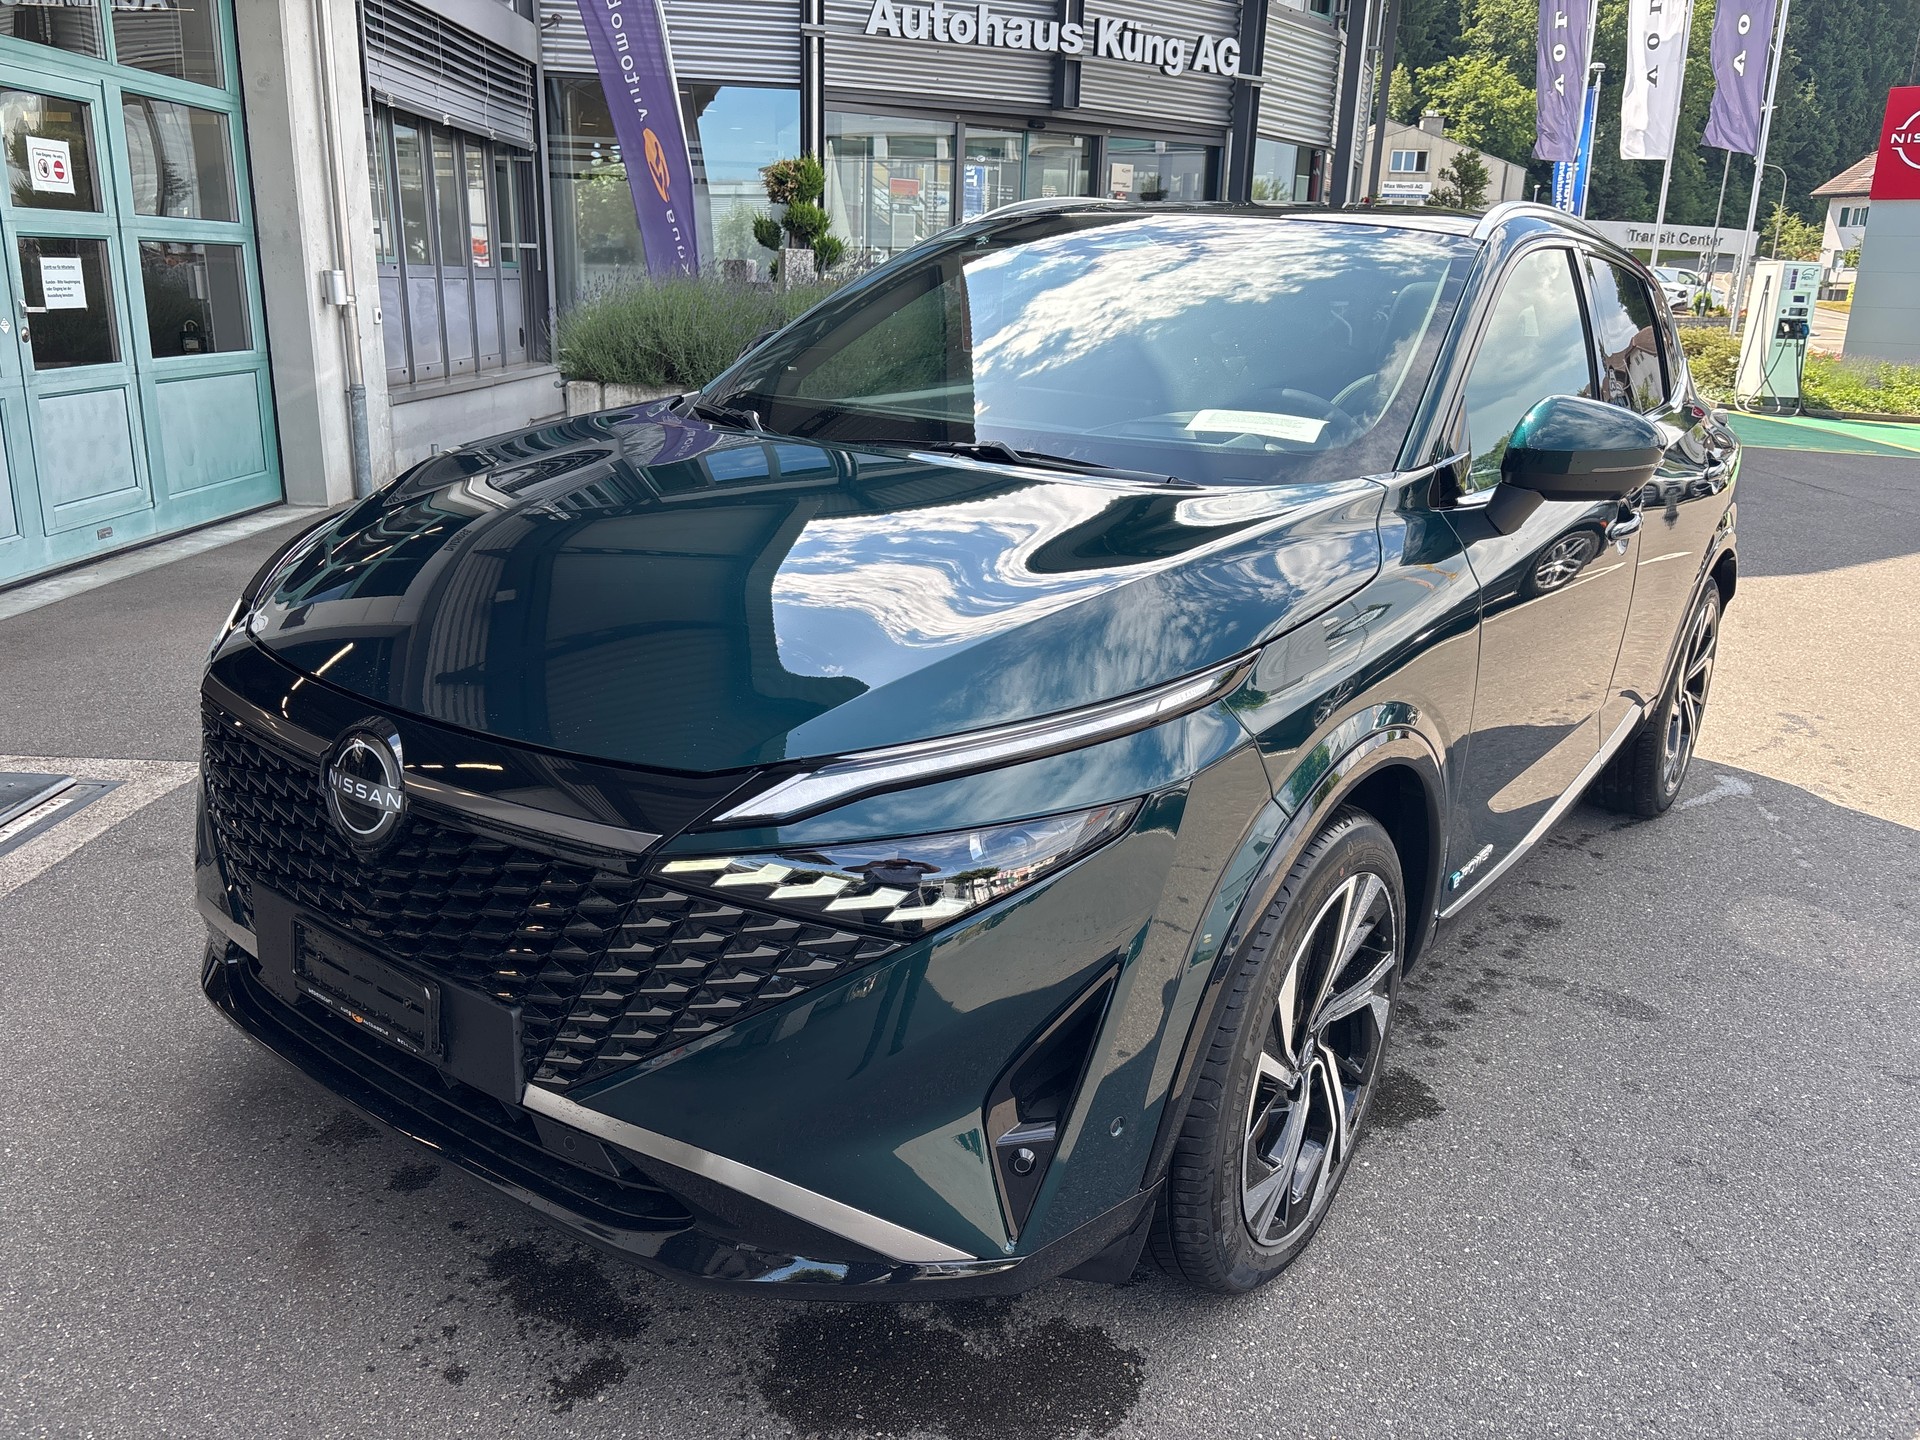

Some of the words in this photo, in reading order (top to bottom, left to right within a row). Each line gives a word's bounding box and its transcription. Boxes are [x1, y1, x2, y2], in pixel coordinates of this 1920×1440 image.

[865, 0, 1084, 54] Autohaus
[1095, 17, 1185, 76] Küng
[1193, 34, 1240, 77] AG
[1680, 232, 1724, 247] Center
[328, 768, 402, 810] NISSAN
